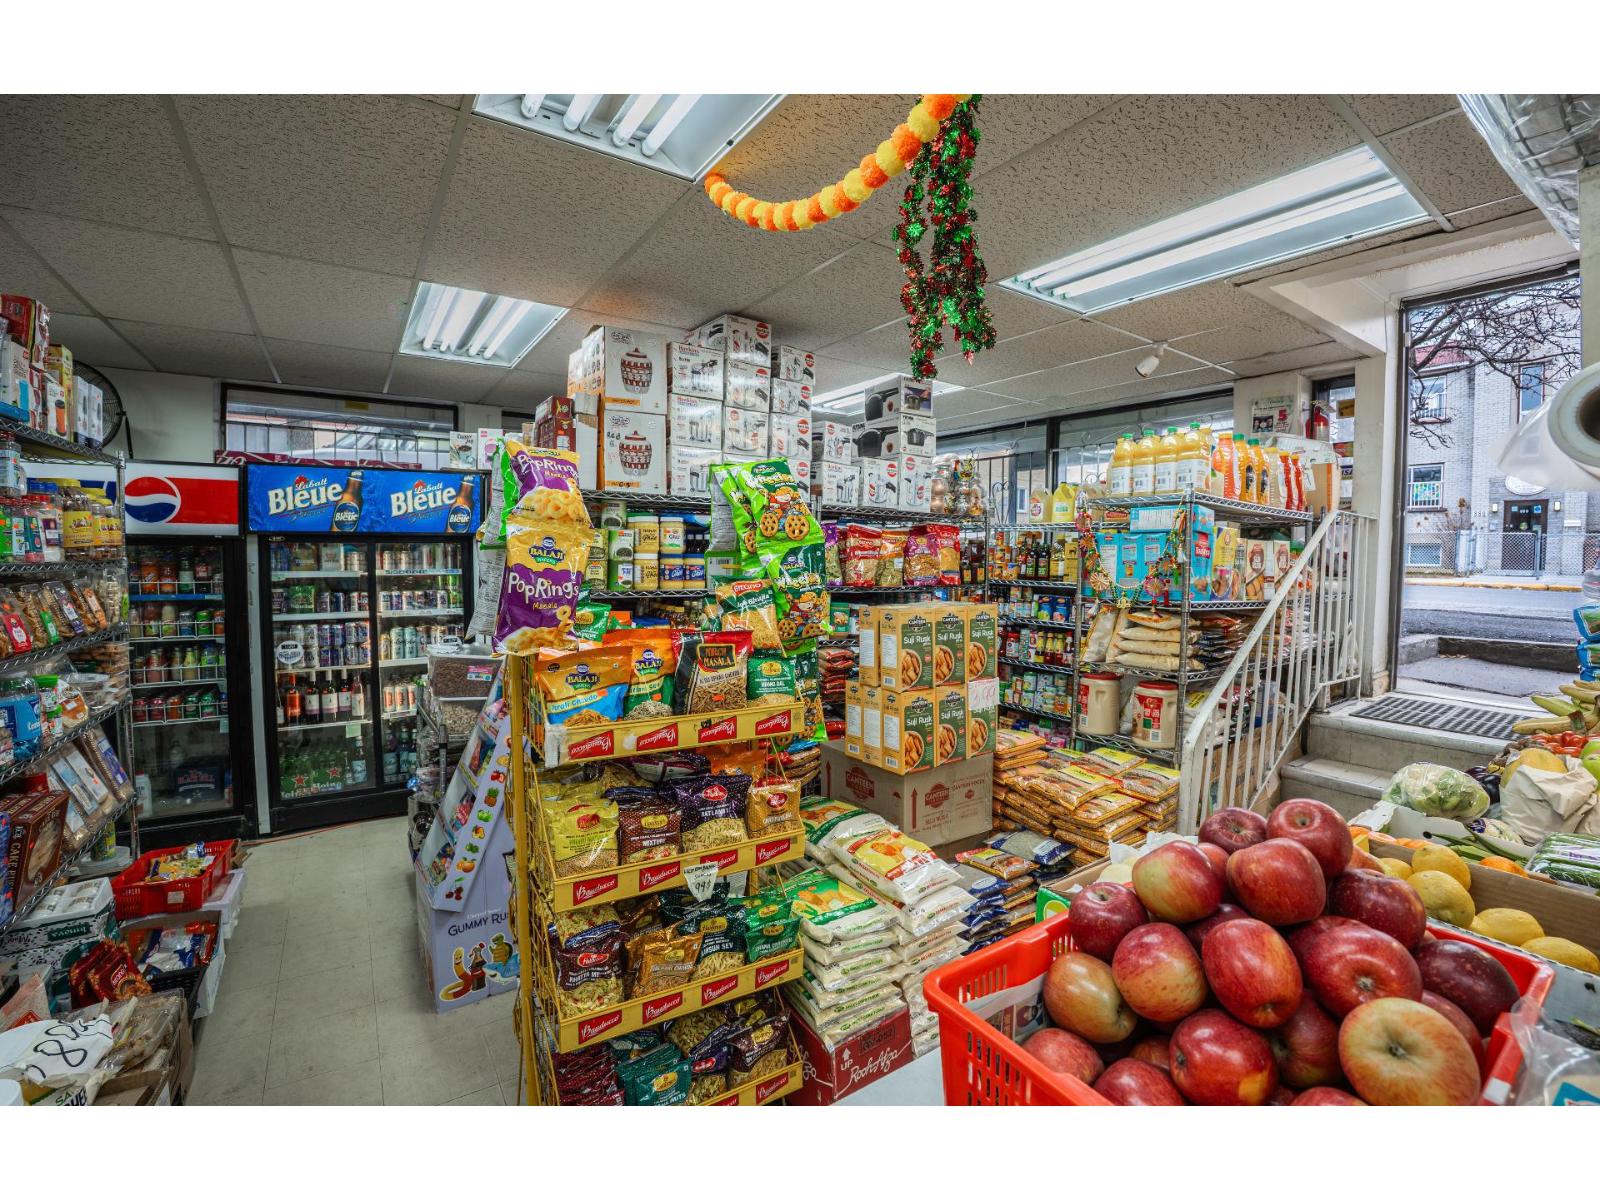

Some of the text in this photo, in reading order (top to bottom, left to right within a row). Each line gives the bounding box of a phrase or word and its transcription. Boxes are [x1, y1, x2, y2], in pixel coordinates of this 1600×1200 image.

[295, 478, 328, 491] Labatt
[414, 482, 443, 494] Labatt
[268, 483, 343, 515] Bleue
[390, 487, 457, 517] Bleue
[530, 548, 564, 560] BALAJI
[904, 635, 931, 645] Suji Rusk
[937, 632, 963, 642] Suji Rusk
[971, 629, 994, 638] Suji Rusk
[567, 675, 598, 684] BALAJI
[906, 715, 933, 727] Suji Rusk
[940, 710, 964, 721] Suji Rusk
[757, 844, 789, 862] Bauducco
[642, 865, 680, 887] Bauducco
[576, 879, 616, 902] Bauducco
[448, 911, 510, 937] GUMMY RU
[757, 963, 789, 985] Bauducco
[703, 979, 738, 1002] Bauducco
[645, 996, 682, 1021] Bauducco
[581, 1014, 622, 1042] Bauducco
[840, 1059, 854, 1071] UP
[757, 1077, 788, 1101] Bauducco
